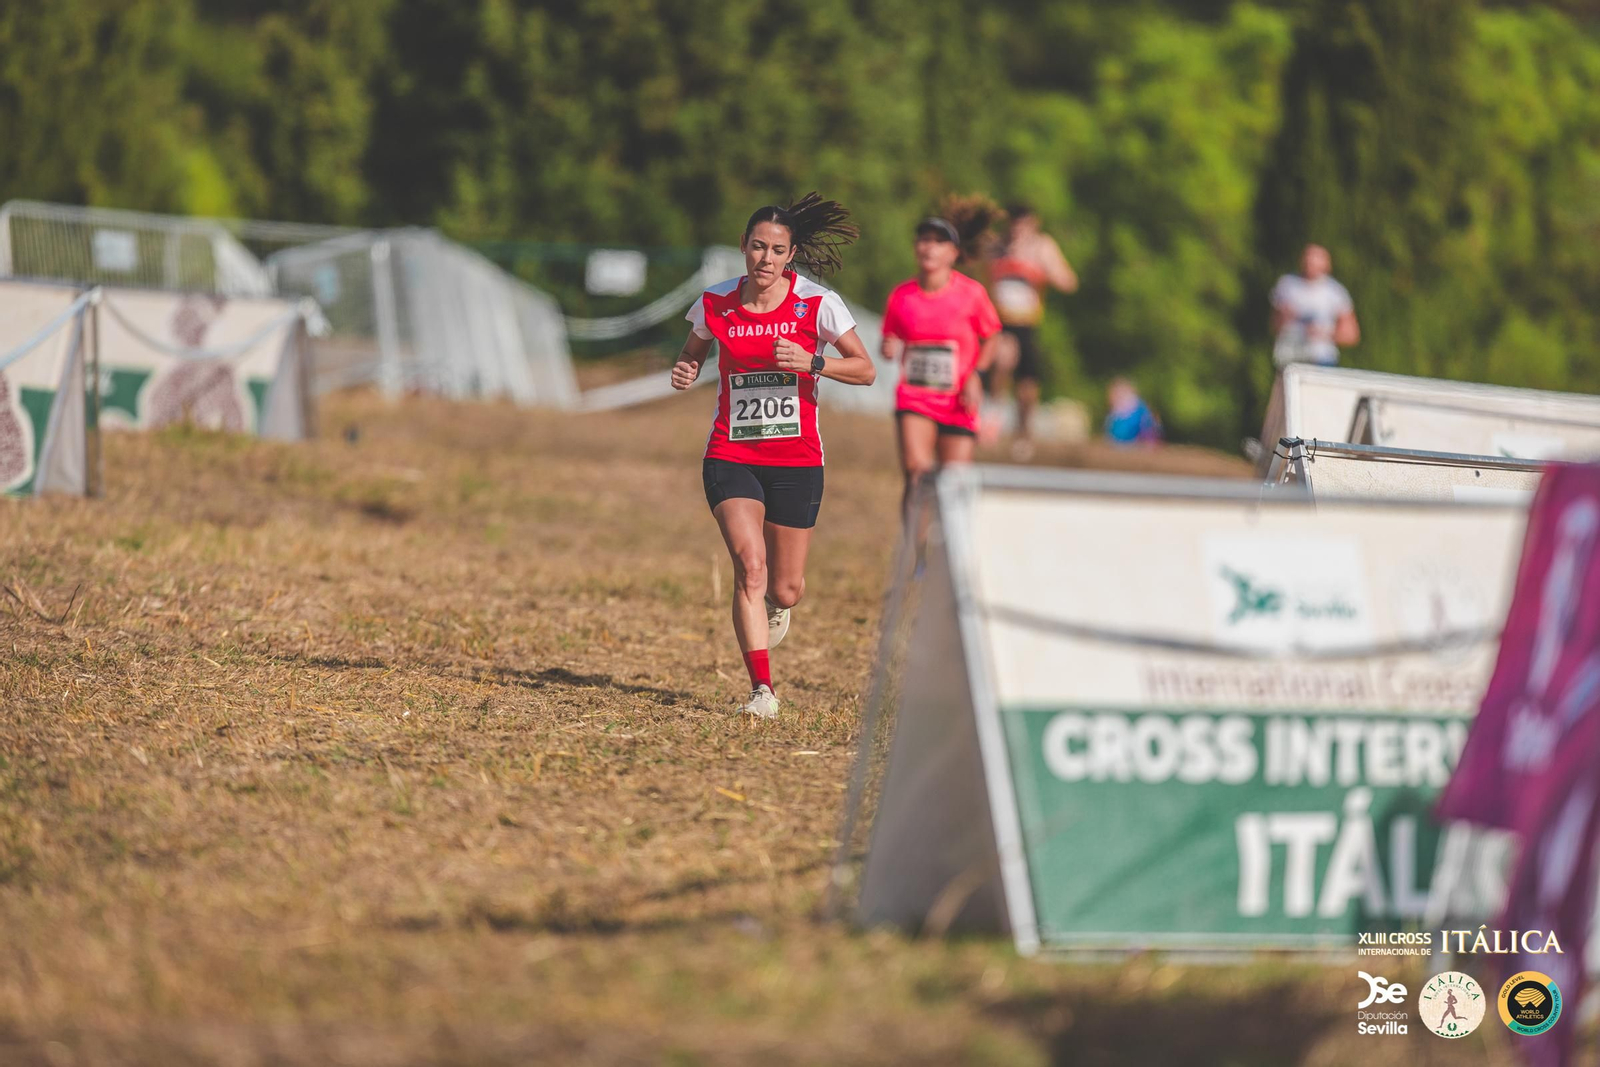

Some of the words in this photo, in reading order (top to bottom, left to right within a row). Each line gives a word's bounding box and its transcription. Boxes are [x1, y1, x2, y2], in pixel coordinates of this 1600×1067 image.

[728, 321, 797, 339] GUADAJOZ
[736, 396, 795, 421] 2206
[1043, 713, 1258, 785] CROSS
